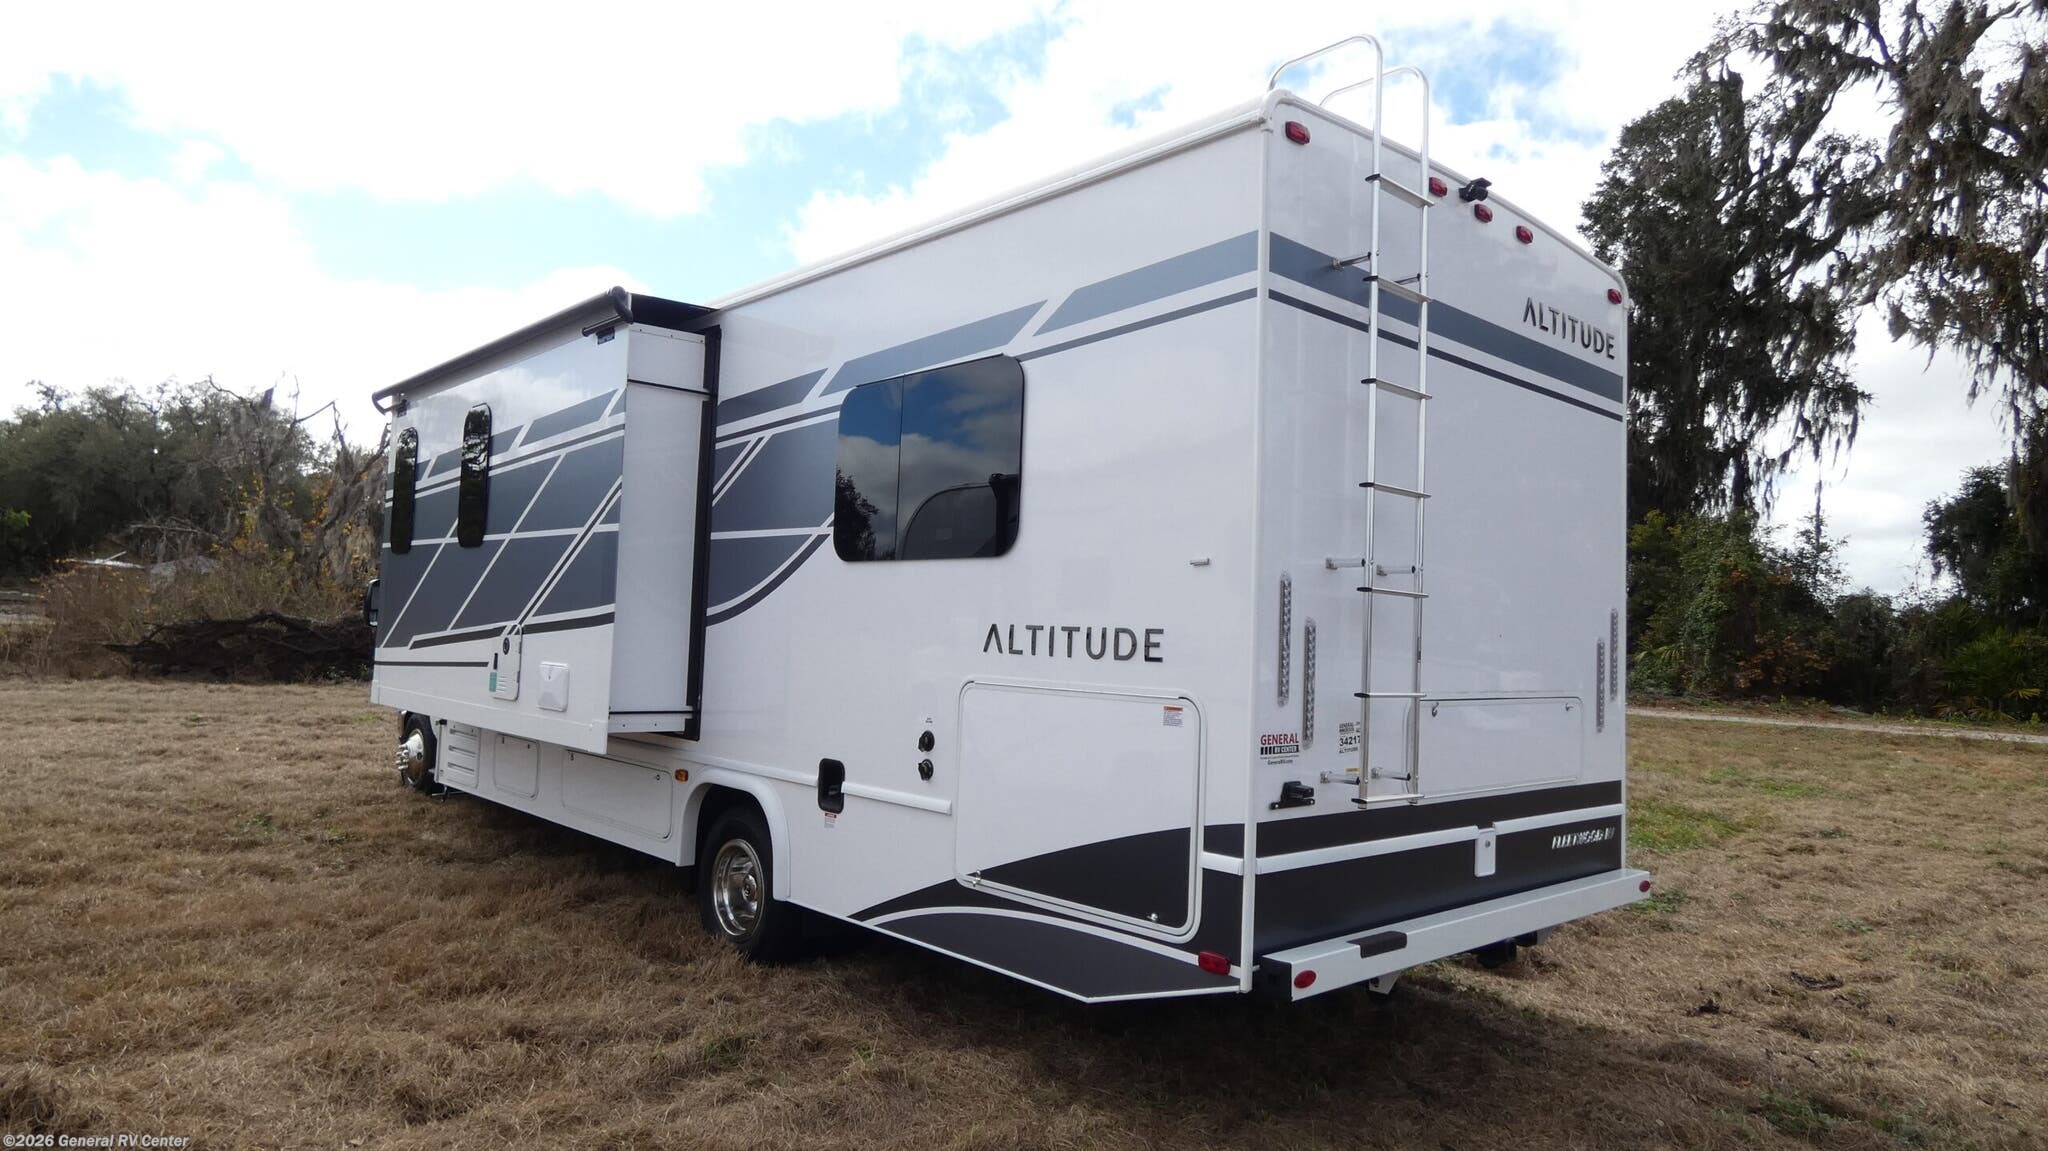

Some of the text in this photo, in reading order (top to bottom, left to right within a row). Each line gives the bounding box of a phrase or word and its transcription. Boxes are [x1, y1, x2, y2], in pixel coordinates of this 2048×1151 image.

[1523, 297, 1615, 360] ALTITUDE
[983, 623, 1164, 663] ALTITUDE
[1261, 733, 1299, 746] GENERAL
